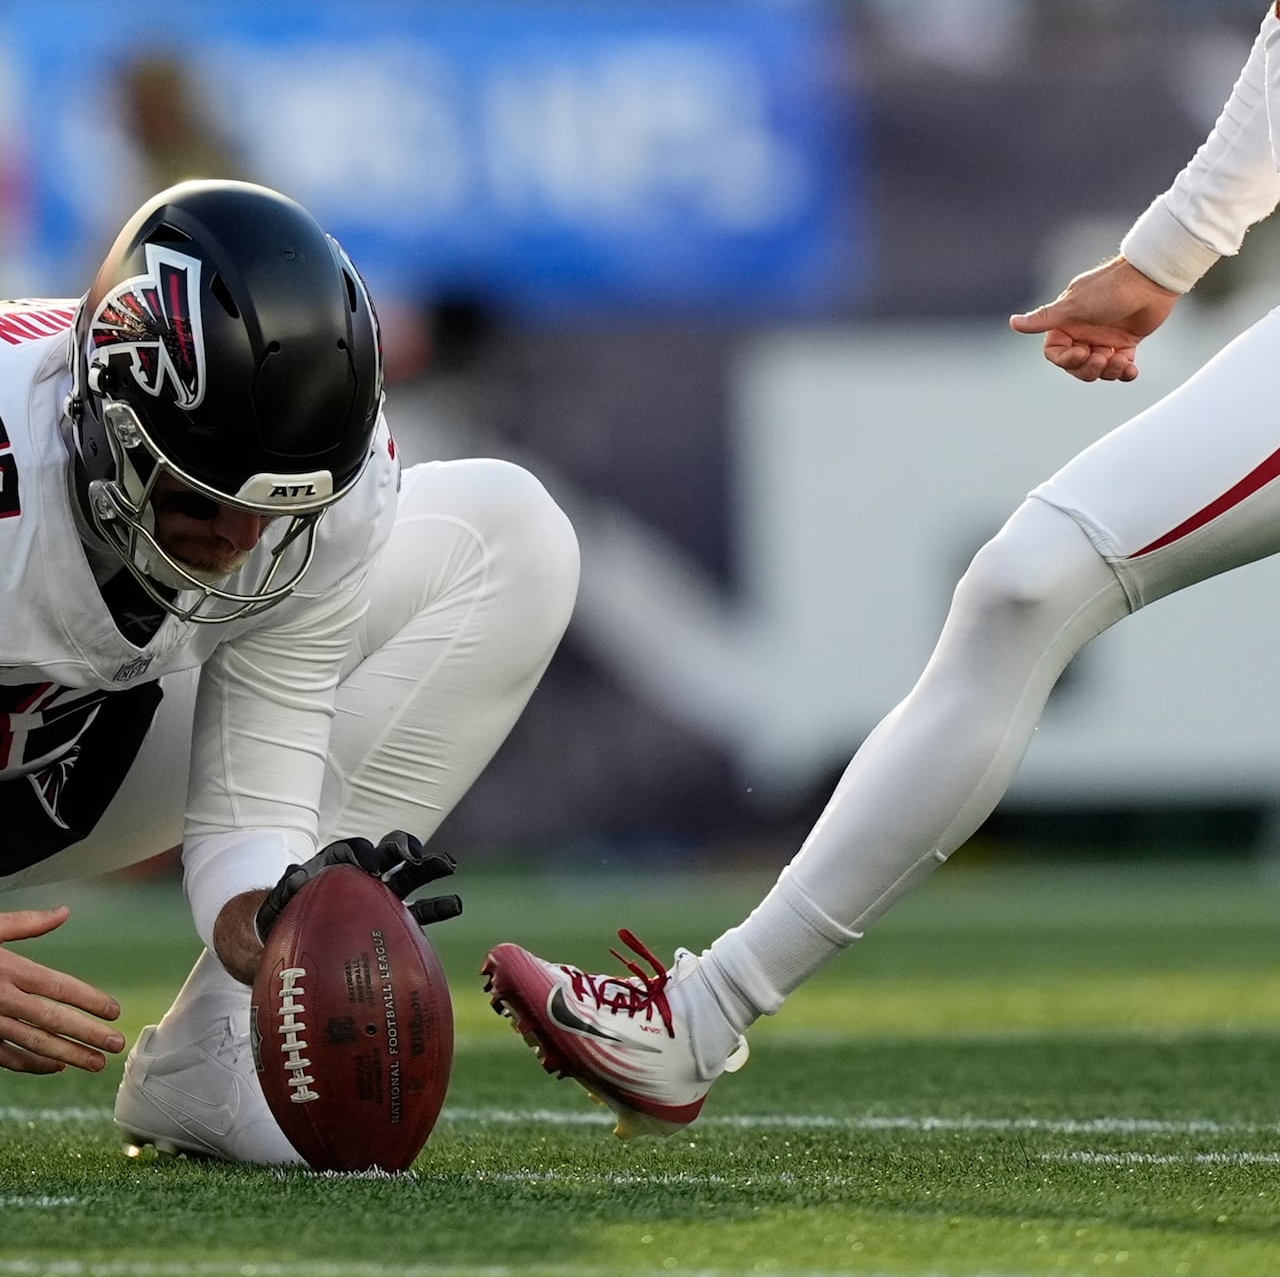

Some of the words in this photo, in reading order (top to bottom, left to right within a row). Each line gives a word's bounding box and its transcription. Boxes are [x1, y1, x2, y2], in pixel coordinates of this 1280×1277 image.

[269, 484, 316, 498] ATL
[372, 930, 391, 979] LEAGUE
[384, 984, 399, 1055] FOOTBALL
[390, 1060, 400, 1124] NATIONAL
